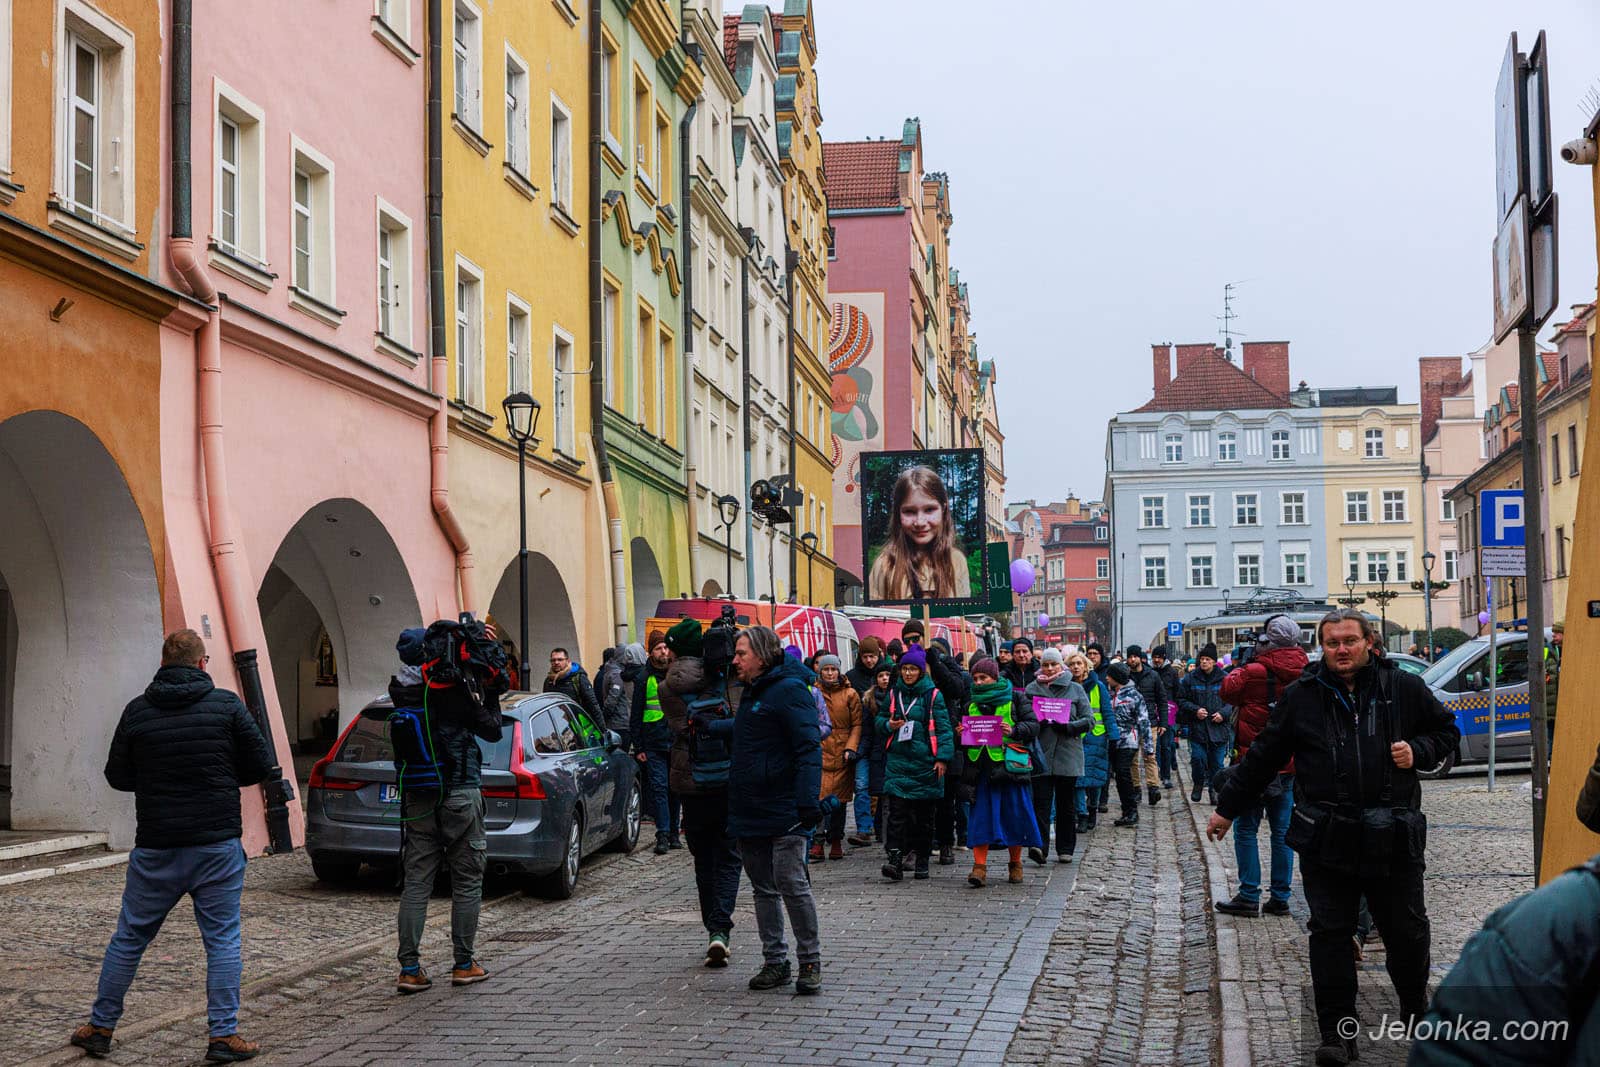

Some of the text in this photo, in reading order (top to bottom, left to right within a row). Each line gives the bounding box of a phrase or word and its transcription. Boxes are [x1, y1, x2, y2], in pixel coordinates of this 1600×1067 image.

[1495, 496, 1525, 540] P
[780, 615, 825, 663] VP
[1171, 623, 1180, 635] P
[1474, 712, 1530, 723] STRŻ MIEJS
